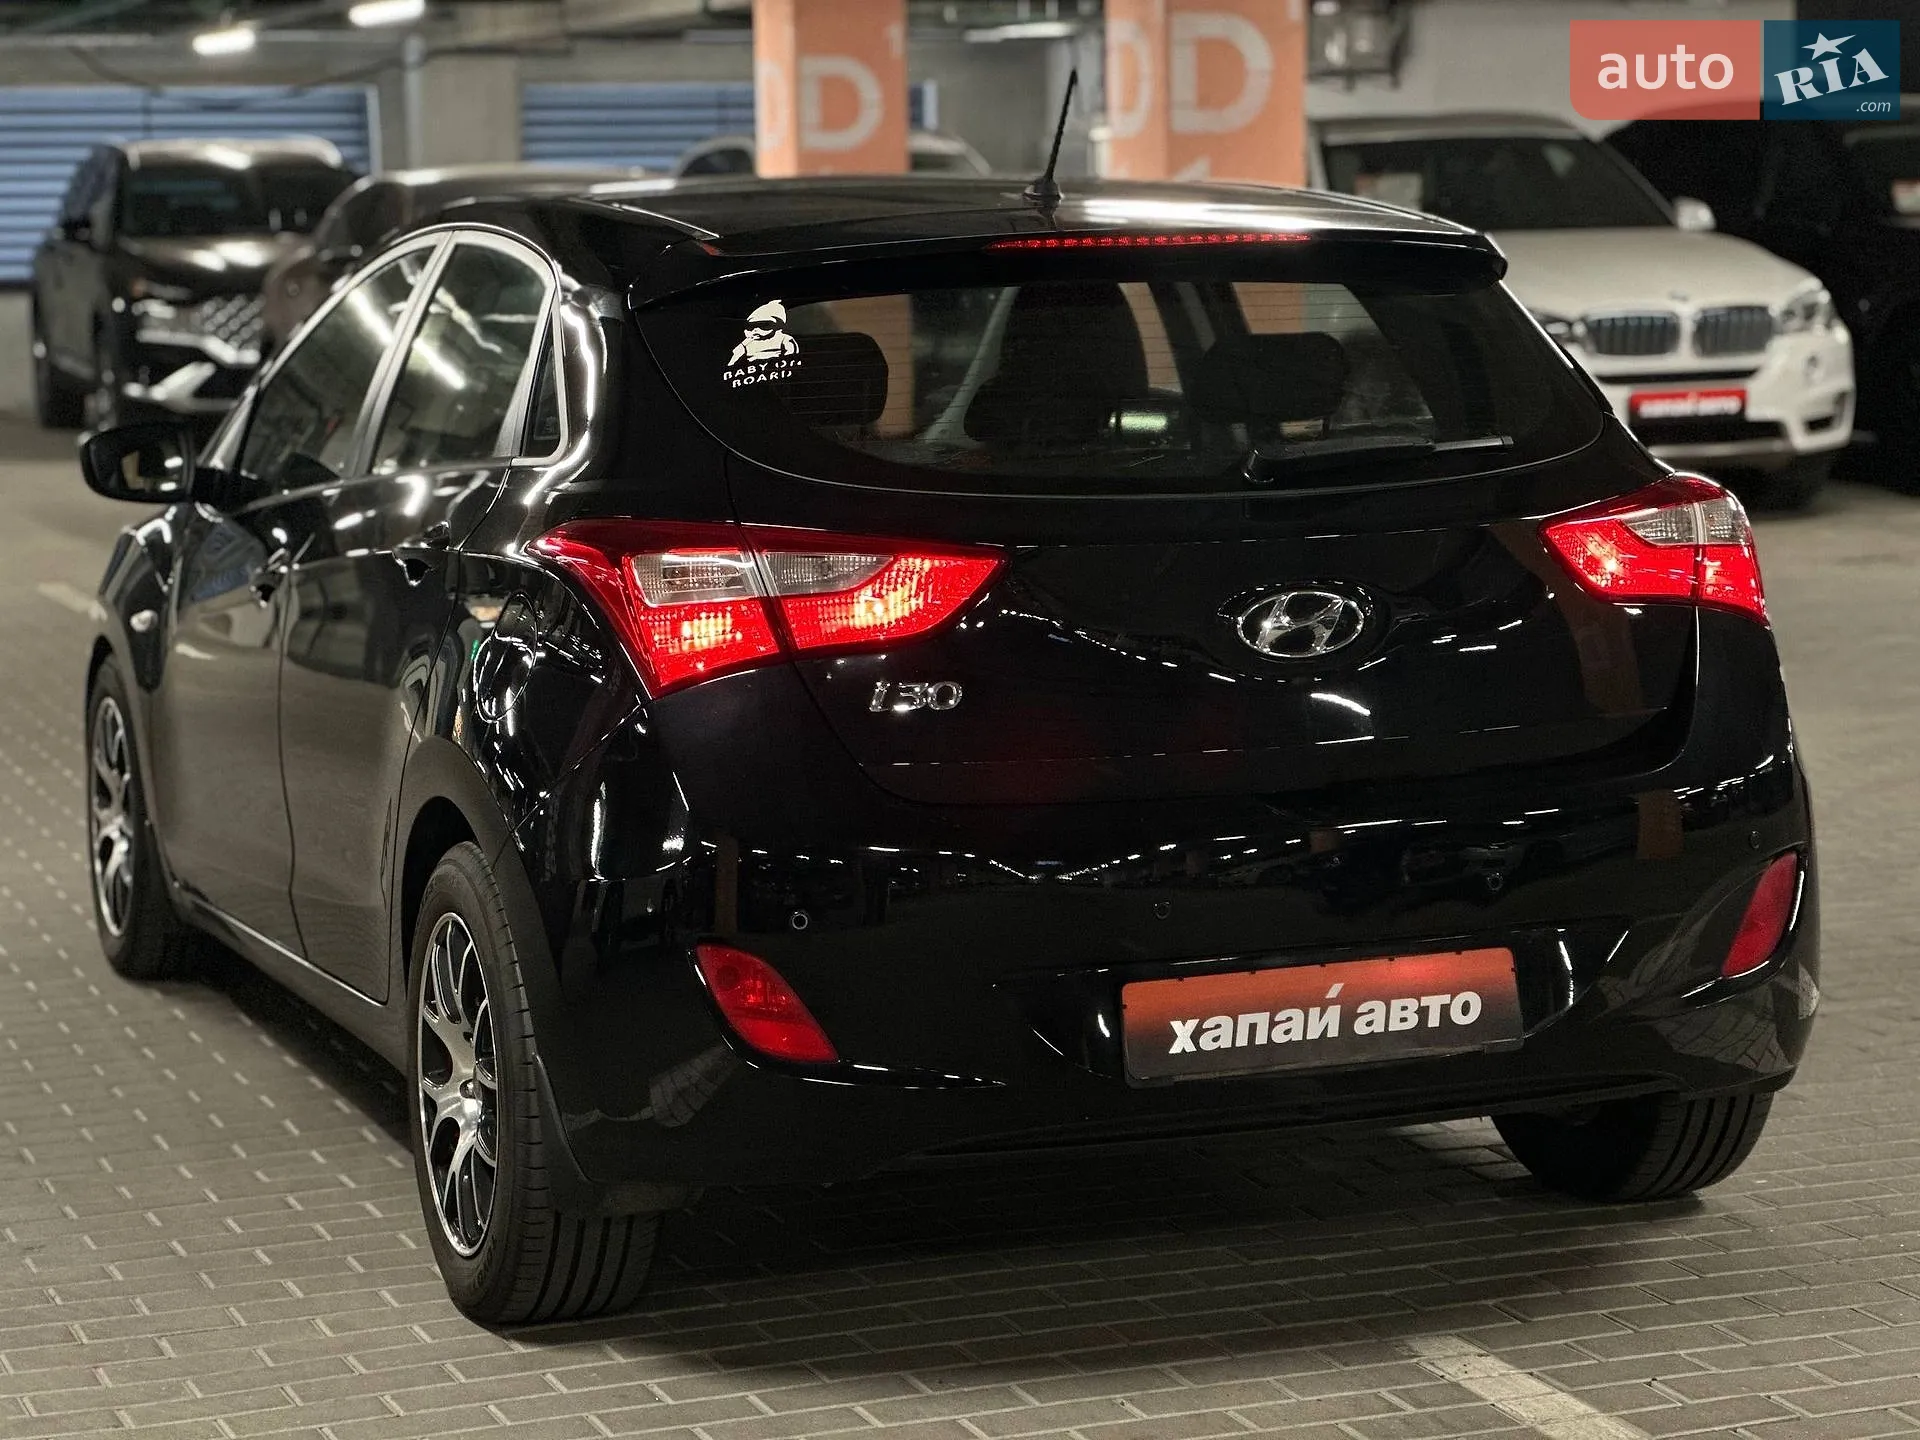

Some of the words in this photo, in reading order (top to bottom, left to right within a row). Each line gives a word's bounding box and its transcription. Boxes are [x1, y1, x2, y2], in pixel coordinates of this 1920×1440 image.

[1171, 11, 1274, 135] D
[801, 54, 885, 151] D
[723, 362, 769, 381] BABY
[732, 370, 792, 388] BOARD
[868, 680, 963, 712] i30
[1353, 990, 1483, 1036] авто
